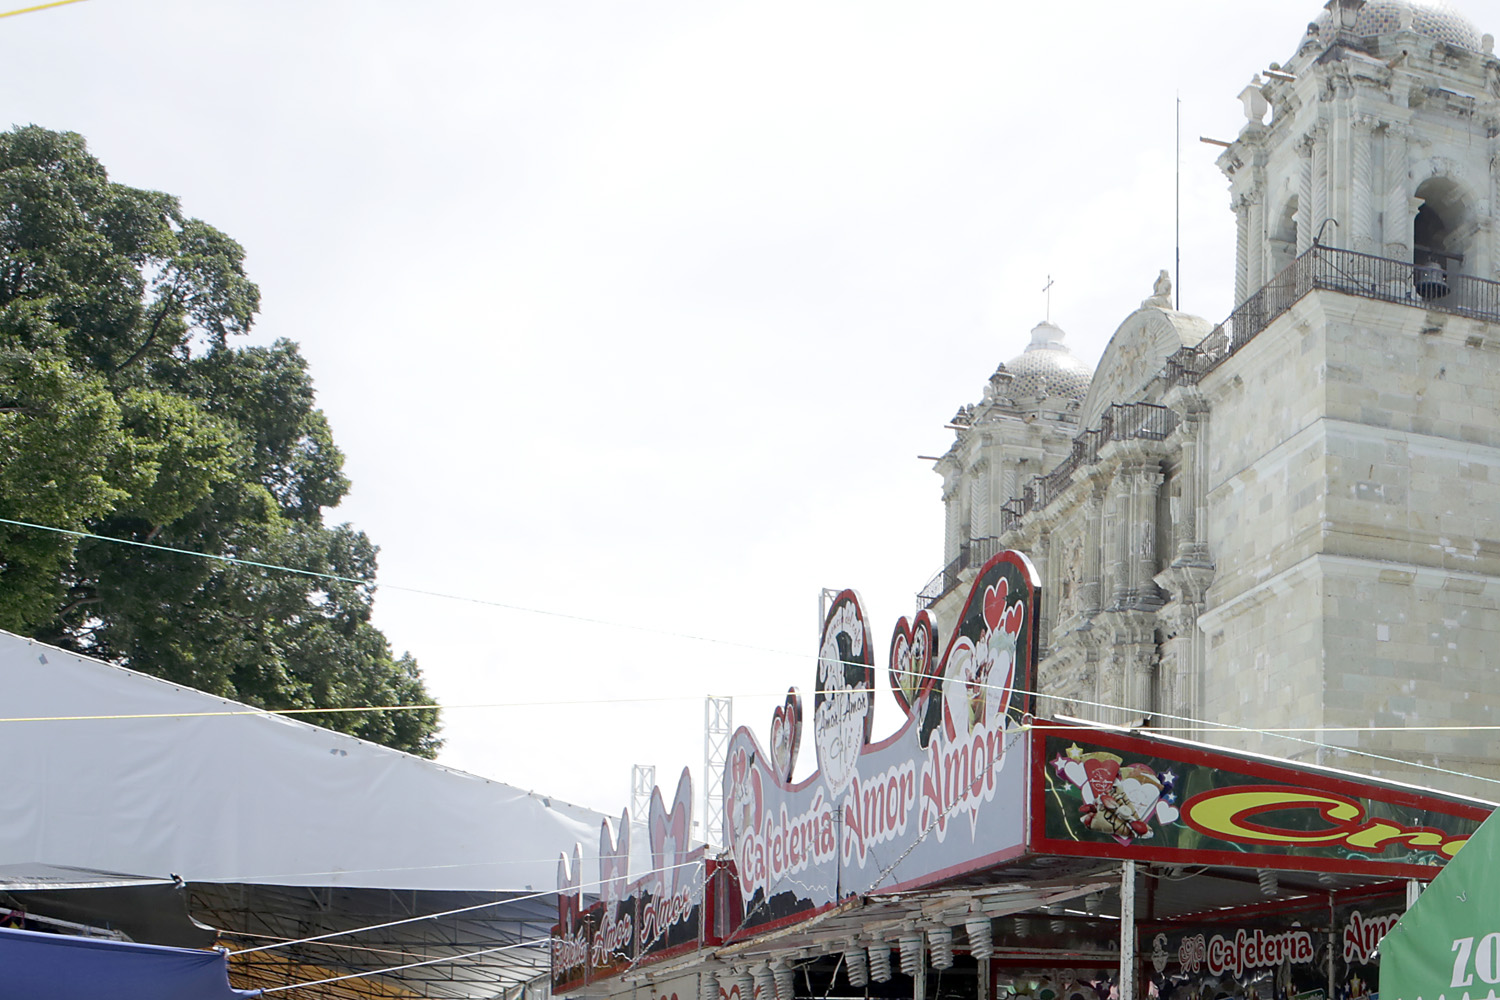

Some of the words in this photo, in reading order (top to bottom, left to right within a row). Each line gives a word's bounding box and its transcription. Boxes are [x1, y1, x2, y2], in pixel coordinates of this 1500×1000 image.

[741, 793, 836, 893] Cafetería
[844, 768, 914, 861] Amor
[921, 725, 1004, 834] Amor
[641, 882, 694, 944] Amor
[1209, 932, 1312, 976] Cafetería
